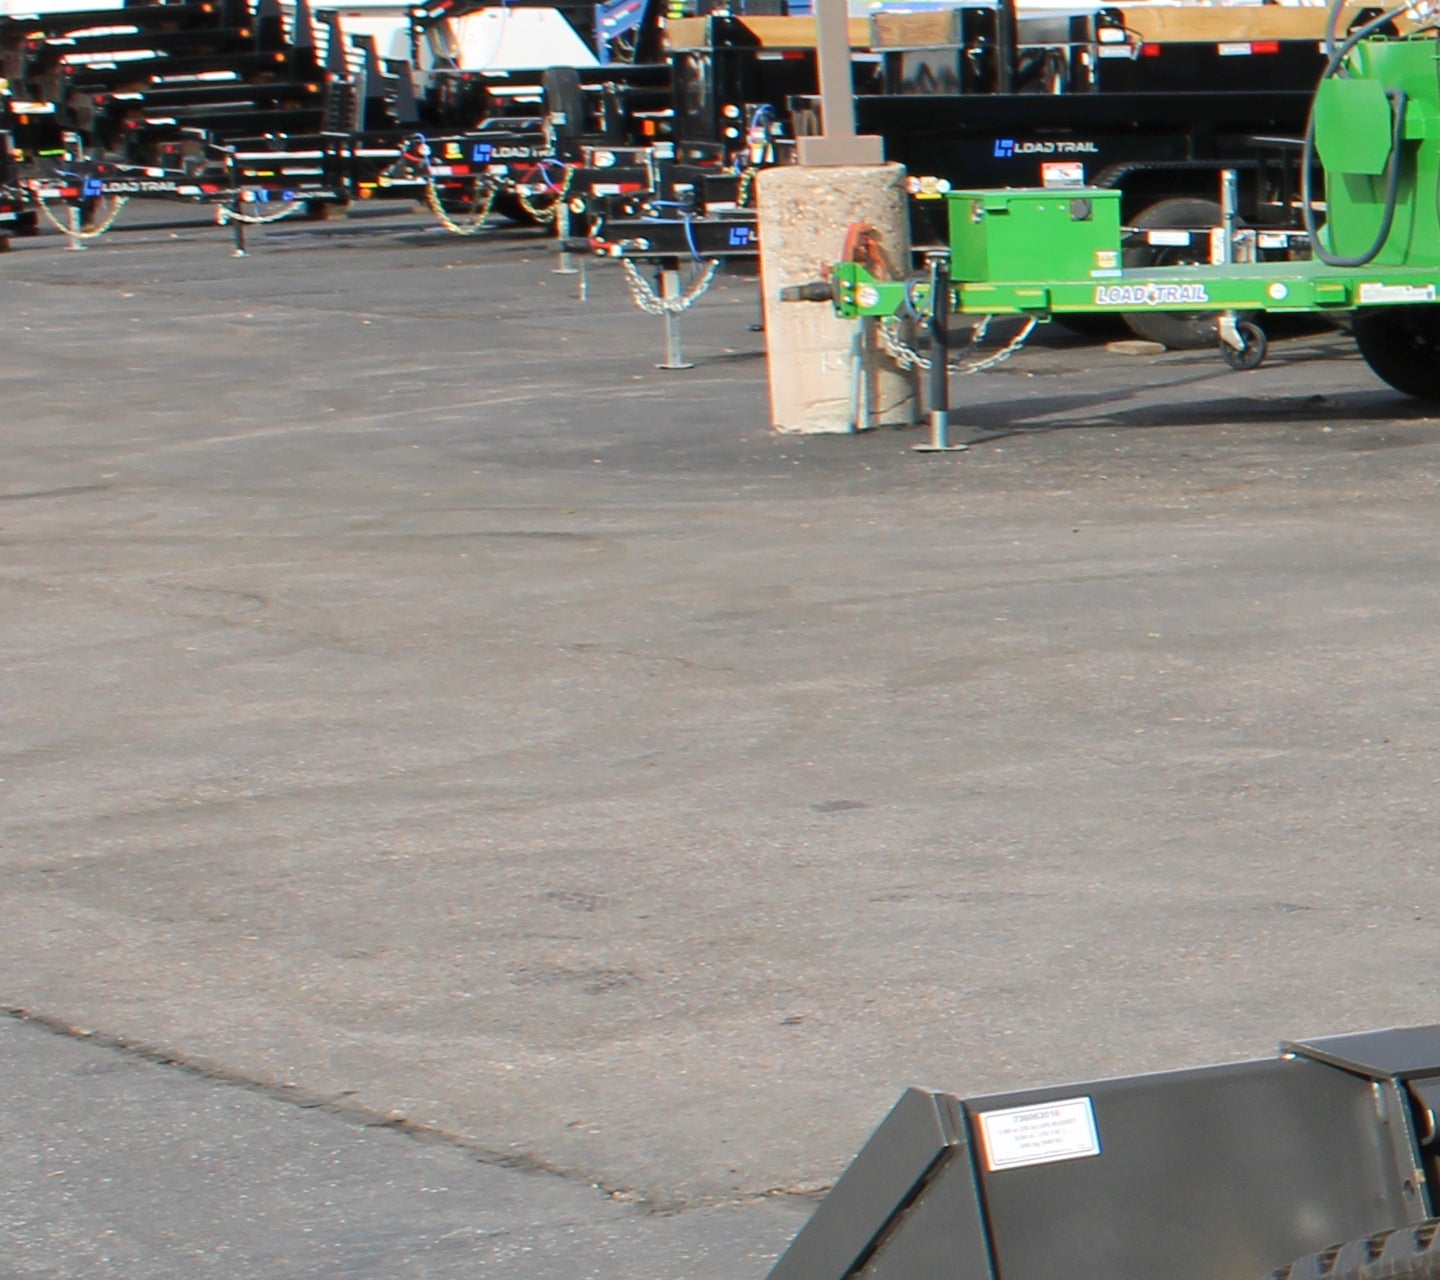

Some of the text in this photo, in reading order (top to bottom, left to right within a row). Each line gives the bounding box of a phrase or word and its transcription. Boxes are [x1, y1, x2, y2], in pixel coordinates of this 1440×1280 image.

[491, 147, 529, 158] LOAD
[1014, 142, 1055, 154] LOAD
[1056, 141, 1099, 153] TRAIL
[102, 181, 139, 193] LOAD
[1094, 284, 1209, 305] LOAD TRAIL
